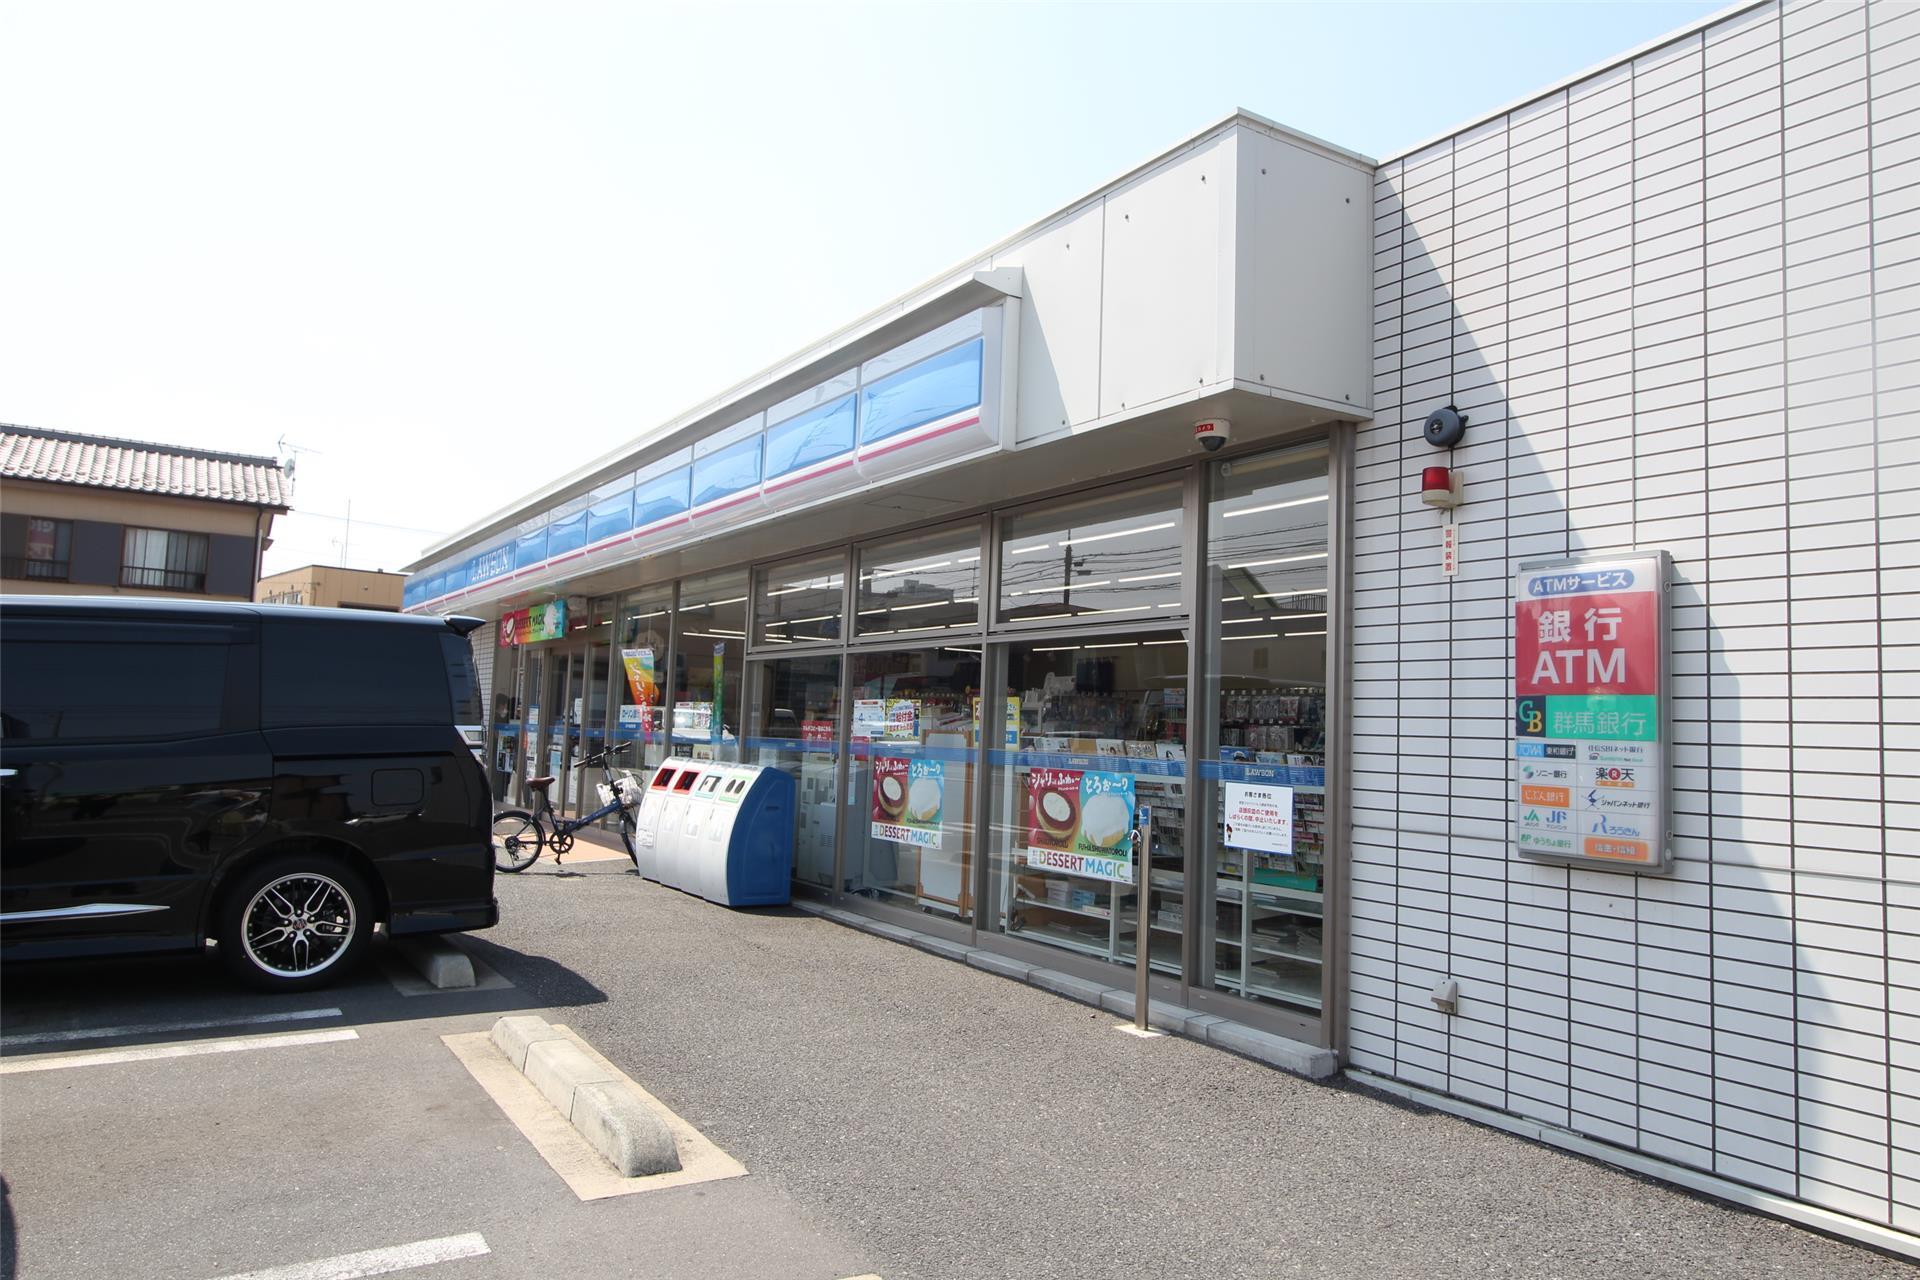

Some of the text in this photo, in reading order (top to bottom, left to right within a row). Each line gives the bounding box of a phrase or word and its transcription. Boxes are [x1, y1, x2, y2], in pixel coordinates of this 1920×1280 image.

[1533, 571, 1627, 593] ATMサービス
[1538, 607, 1622, 643] 銀行
[1531, 648, 1626, 684] ATM
[1553, 711, 1647, 736] 群馬銀行
[1245, 767, 1274, 777] LAWSON
[1536, 769, 1567, 779] ソニー銀行
[1525, 789, 1564, 803] じぶん銀行
[1600, 799, 1650, 809] ジャパンネット銀行
[879, 824, 910, 843] DESSERT
[910, 828, 937, 845] MAGIC
[1609, 826, 1640, 837] ろうきん
[1533, 837, 1571, 848] ゆうちょ銀行
[1039, 850, 1084, 872] DESSERT
[1085, 857, 1125, 878] MAGIC
